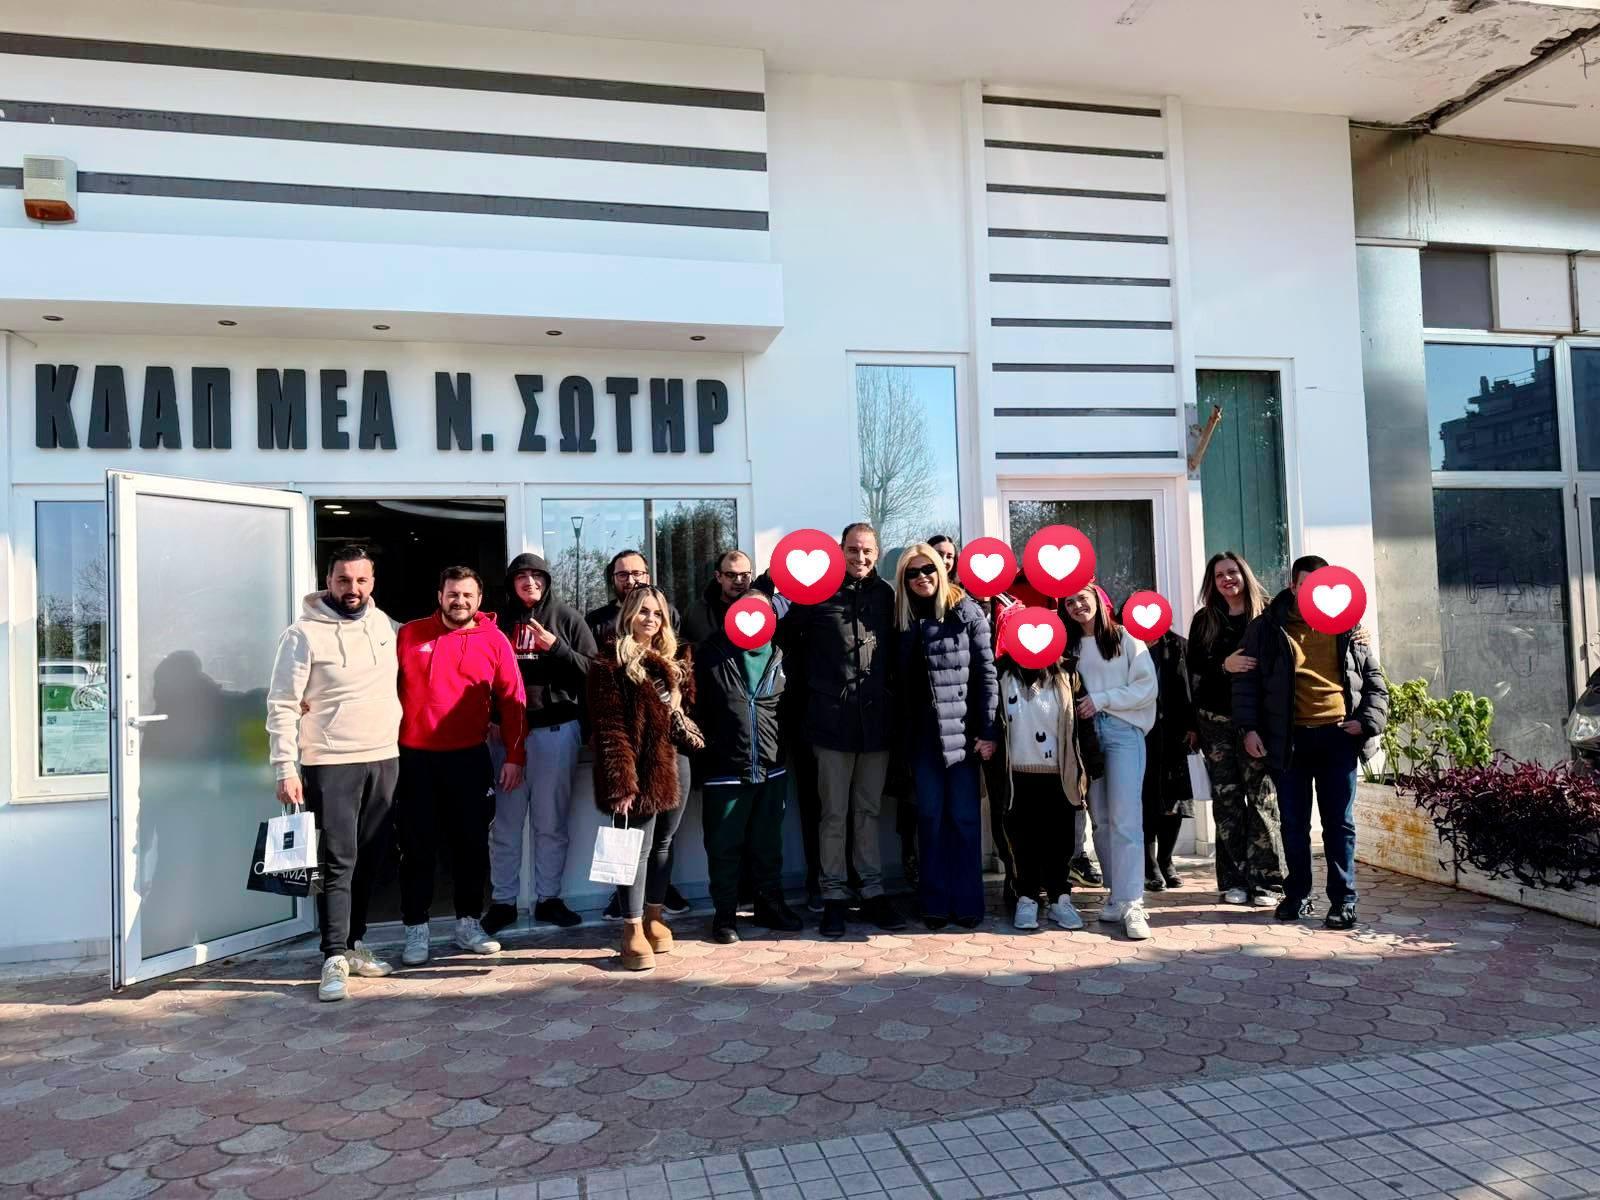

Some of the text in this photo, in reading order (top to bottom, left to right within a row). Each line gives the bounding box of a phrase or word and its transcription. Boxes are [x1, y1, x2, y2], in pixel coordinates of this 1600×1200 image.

[35, 363, 729, 453] ΚΔΑΠ ΜΕΑ Ν. ΣΩΤΗΡ
